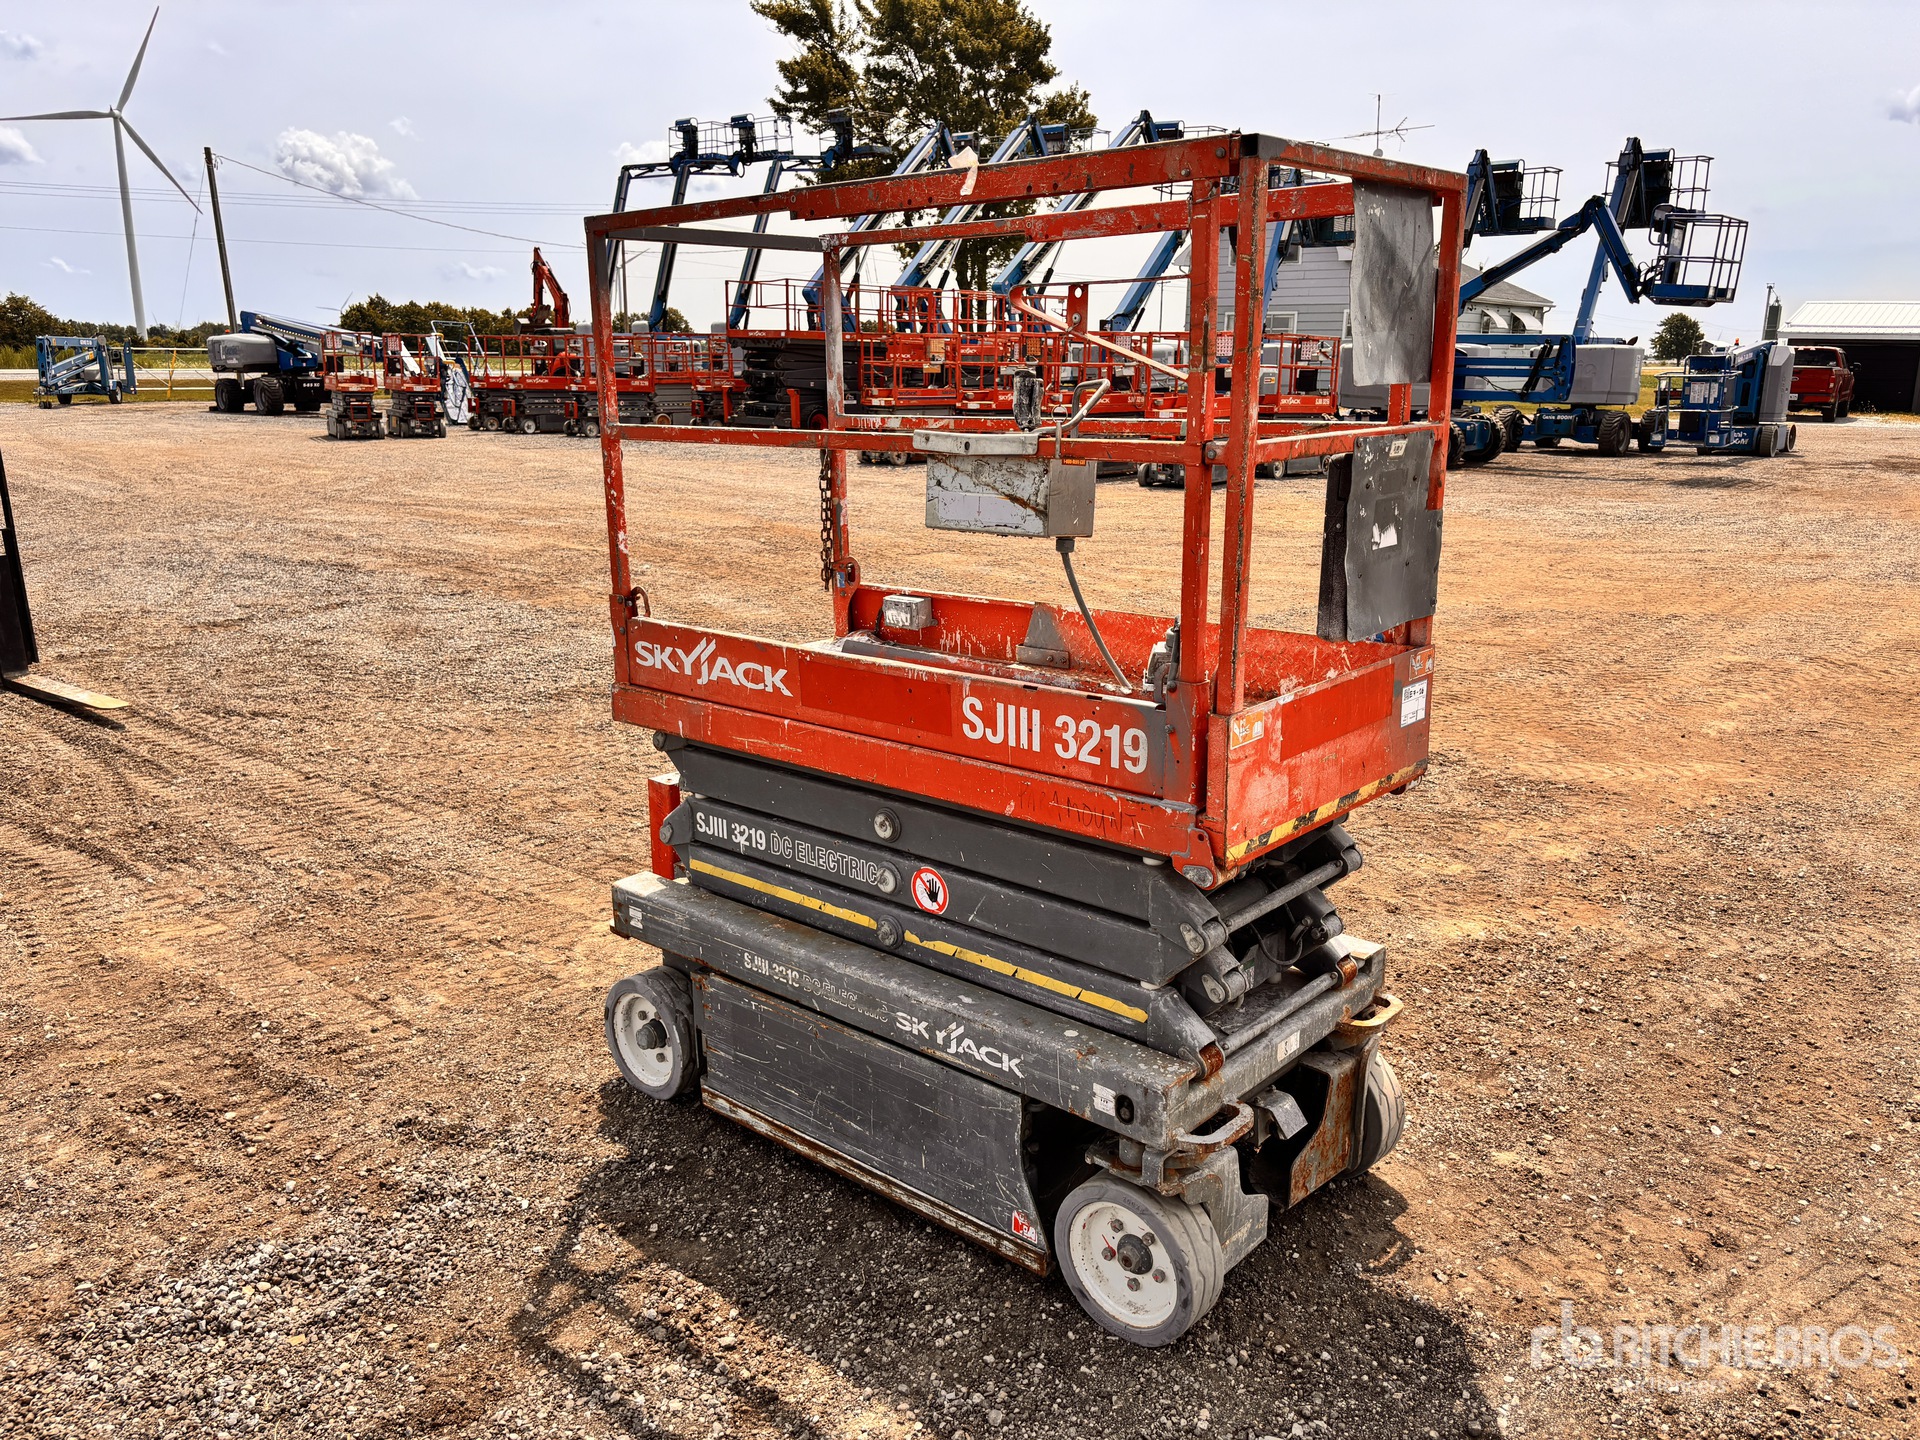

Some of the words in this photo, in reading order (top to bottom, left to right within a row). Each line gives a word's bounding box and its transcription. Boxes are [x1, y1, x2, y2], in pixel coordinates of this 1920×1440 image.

[634, 636, 794, 698] SKYJACK
[961, 696, 1041, 753] SJIII
[1054, 714, 1149, 774] 3219
[696, 811, 728, 840] SJIII
[731, 822, 766, 851] 3219
[770, 830, 793, 858] DC
[795, 839, 880, 886] ELECTRIC
